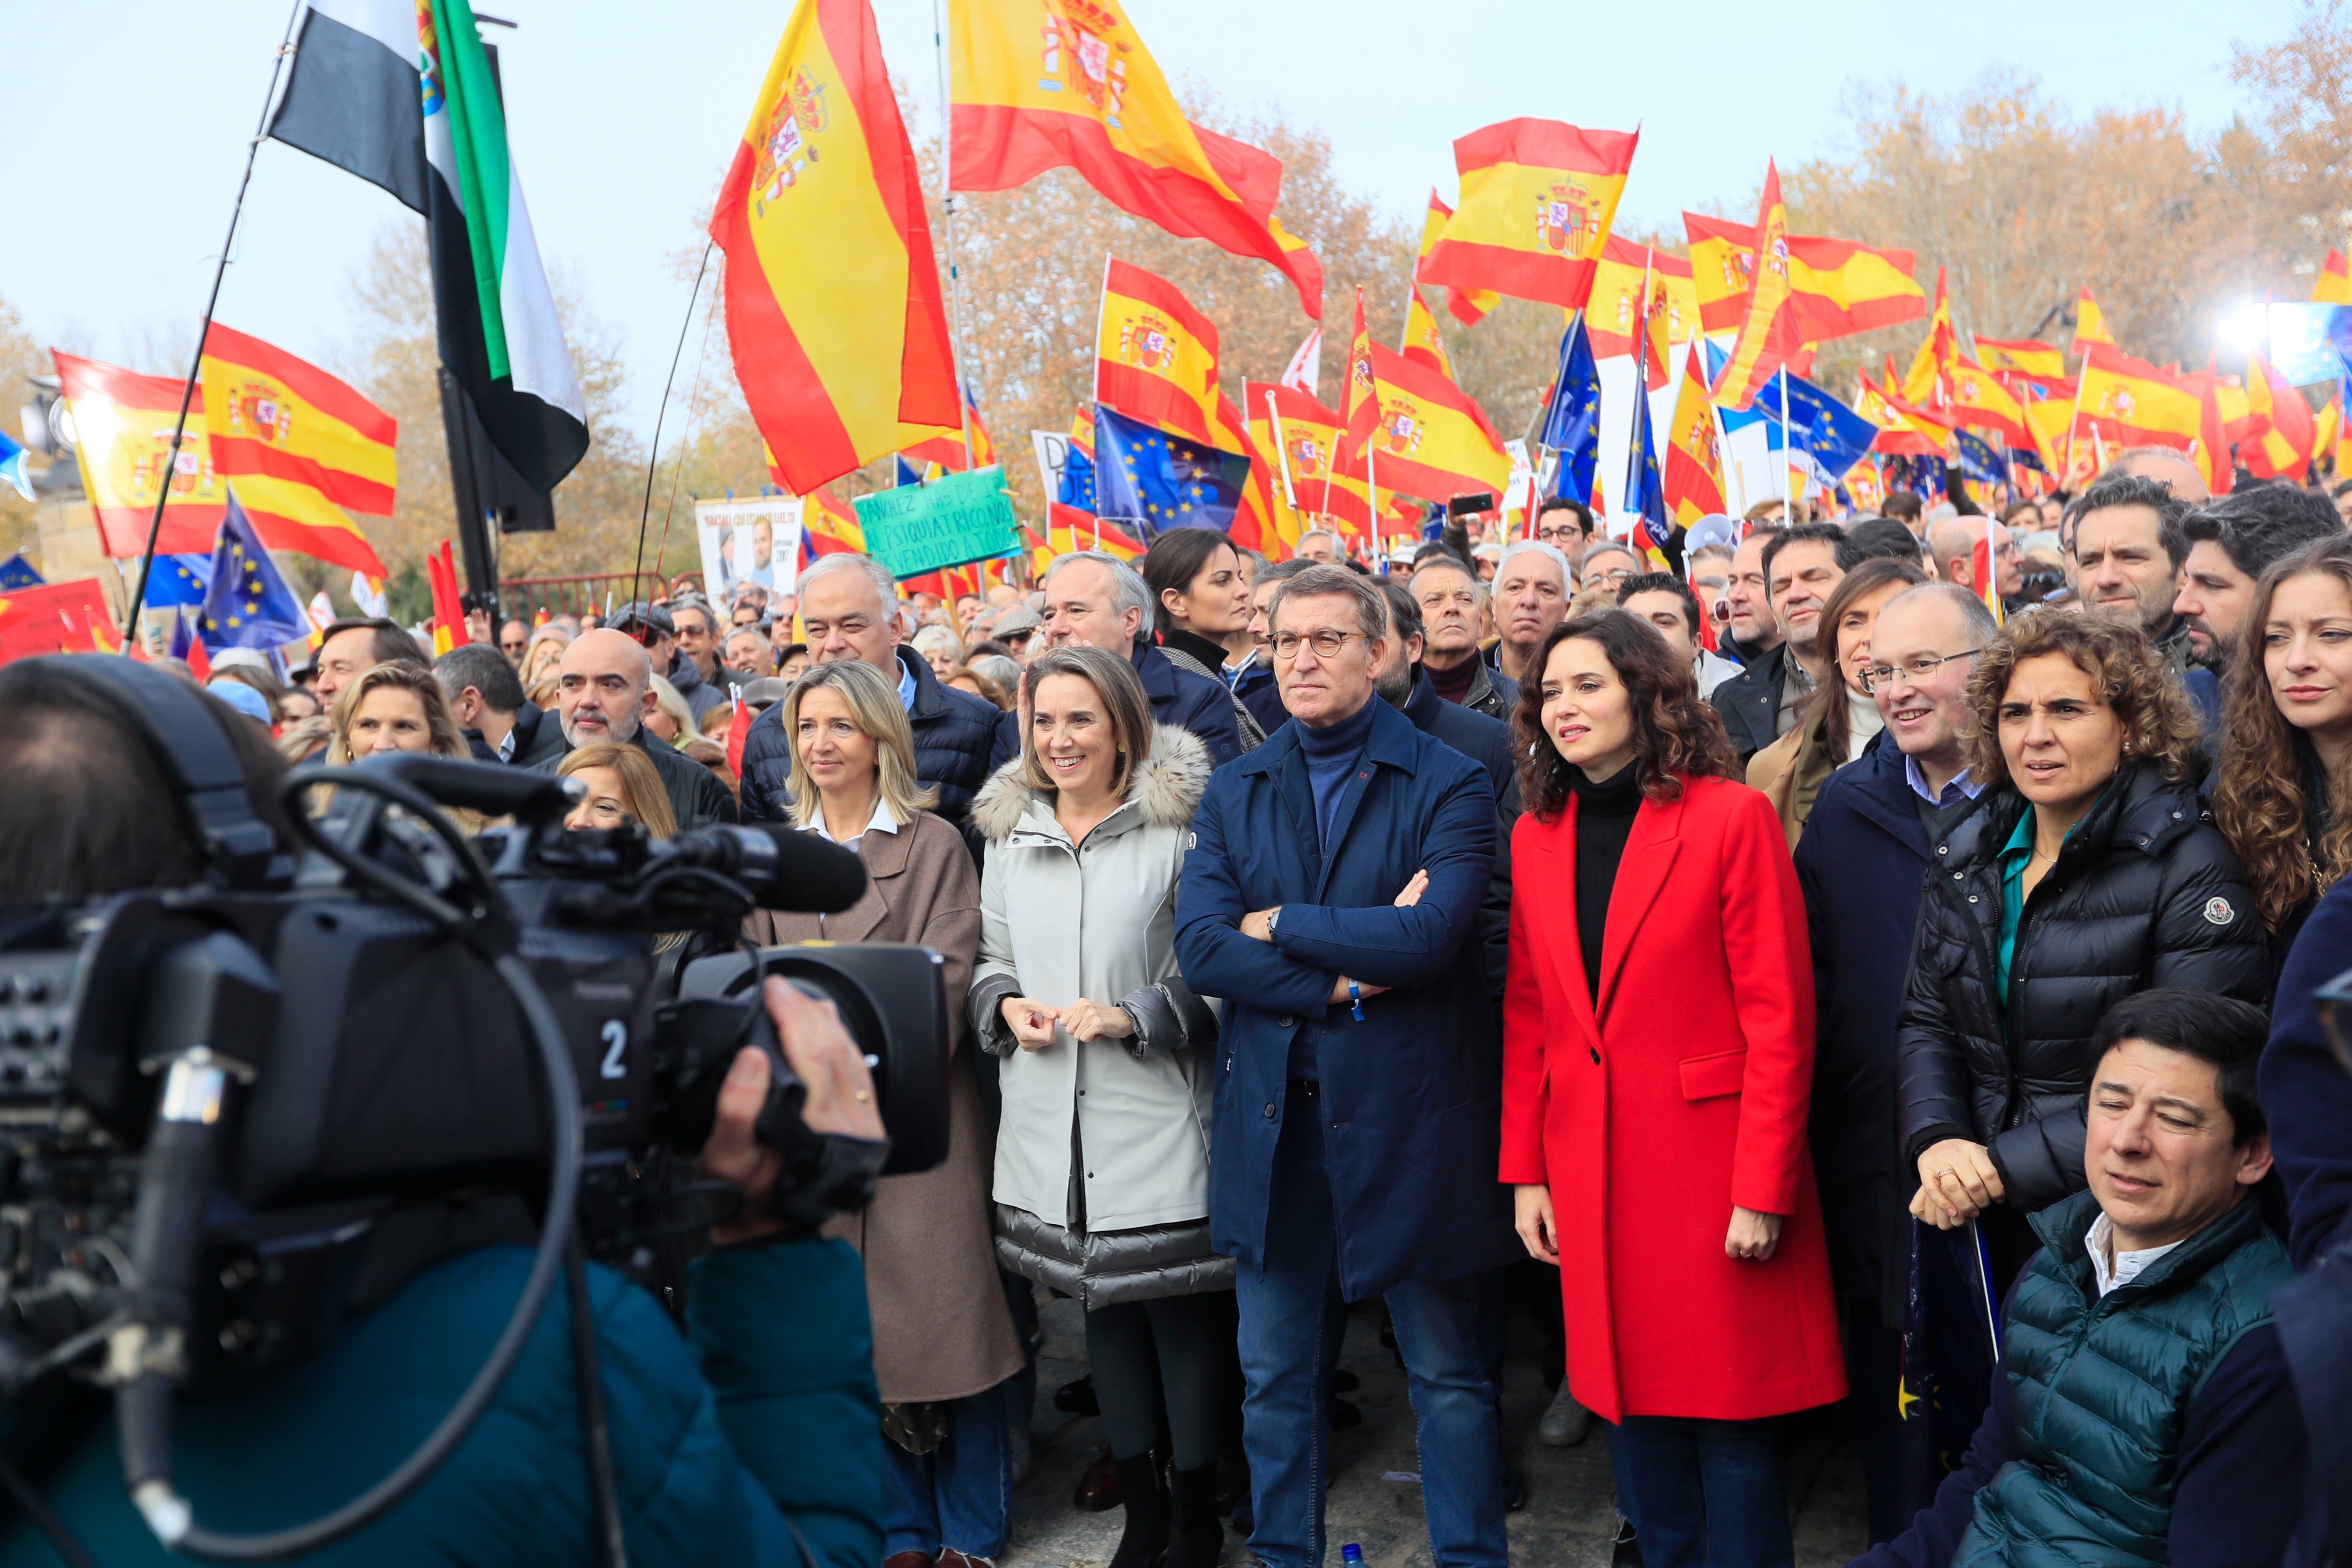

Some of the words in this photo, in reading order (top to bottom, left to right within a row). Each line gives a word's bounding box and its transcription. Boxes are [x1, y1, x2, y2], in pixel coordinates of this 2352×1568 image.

[855, 494, 916, 525] SANCHEZ
[924, 486, 952, 509] HAS
[955, 482, 978, 505] DE
[983, 475, 1001, 498] IR
[865, 528, 886, 554] AL
[893, 539, 958, 573] VENDIDO
[963, 535, 979, 560] A
[600, 1018, 627, 1080] 2
